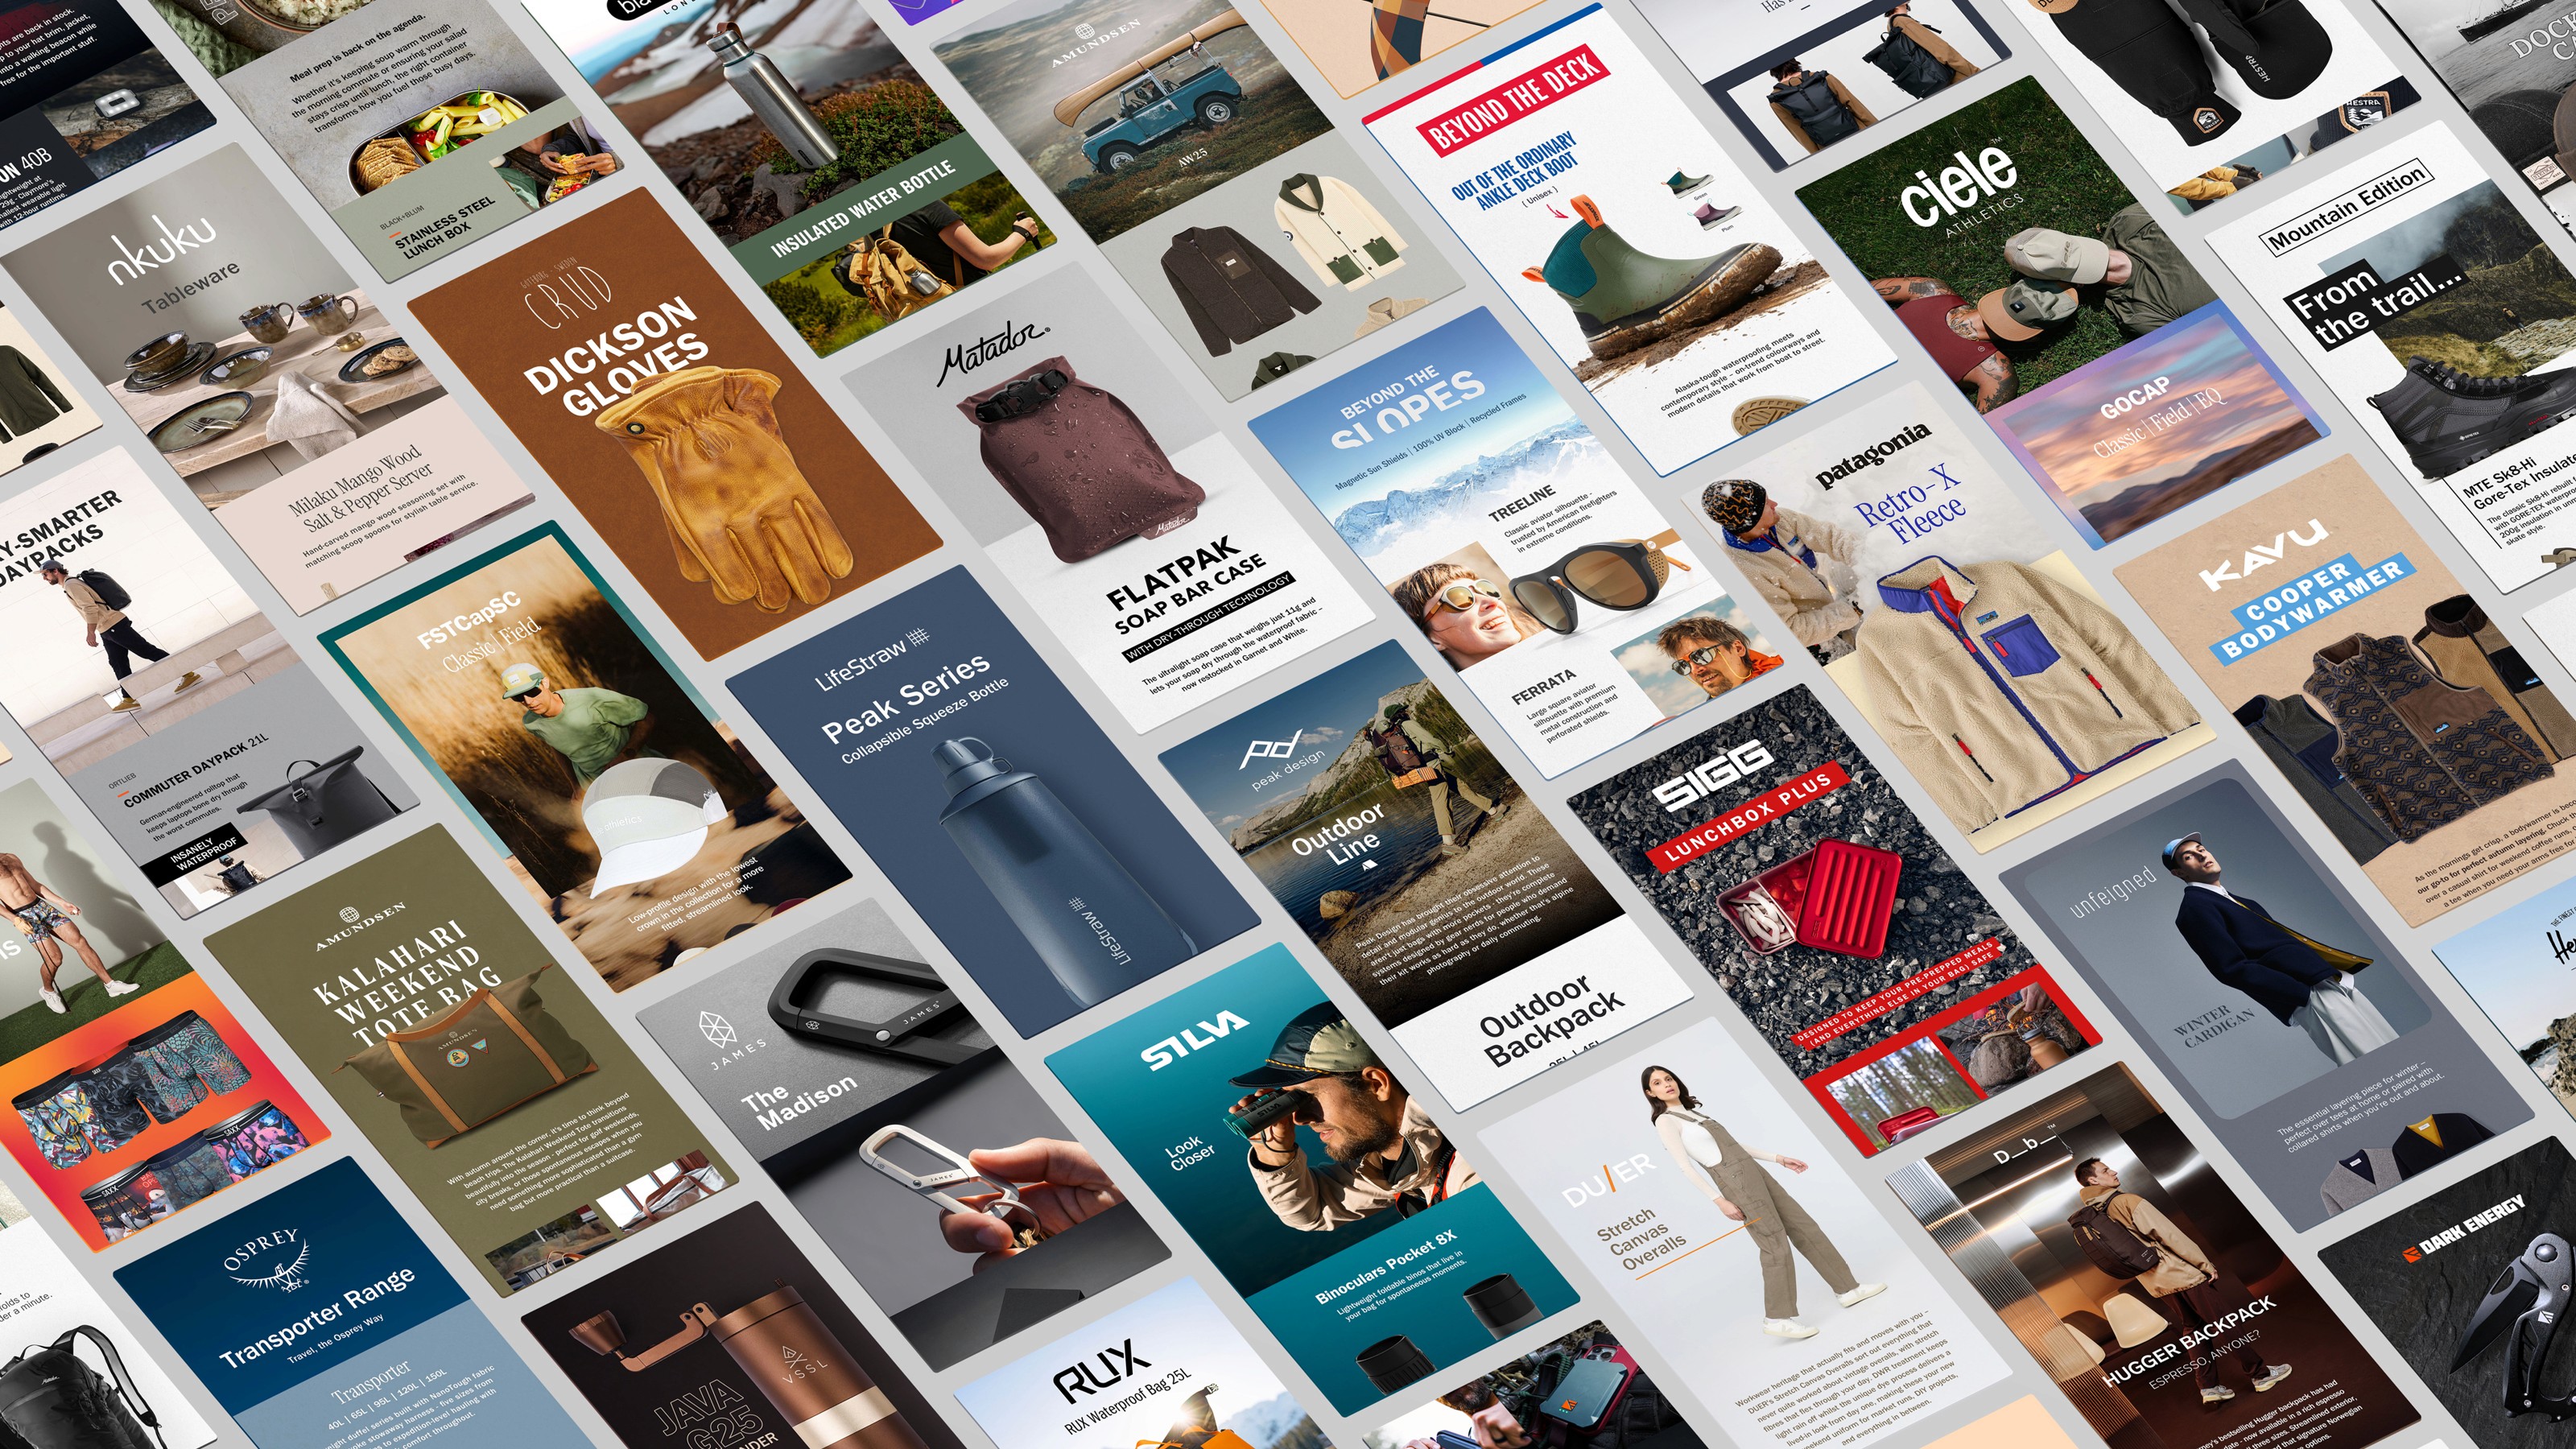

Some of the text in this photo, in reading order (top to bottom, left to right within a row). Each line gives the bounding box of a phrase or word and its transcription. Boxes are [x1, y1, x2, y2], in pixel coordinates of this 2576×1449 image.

[15, 36, 95, 79] for the important stuff.
[289, 68, 313, 83] Meal
[312, 59, 333, 73] prep
[341, 43, 365, 58] back
[365, 38, 377, 47] on
[376, 30, 392, 40] the
[392, 14, 426, 33] agenda.
[1052, 18, 1141, 68] AMUNDSEN
[1428, 52, 1601, 150] BEYOND THE DECK
[21, 147, 52, 170] 40B
[1179, 147, 1208, 167] AW25
[1451, 130, 1577, 201] OUT OF THE ORDINARY
[1476, 151, 1579, 211] ANKLE DECK BOOT
[770, 159, 956, 258] INSULATED WATER BOTTLE
[1526, 189, 1554, 204] Unisex
[1693, 192, 1708, 201] Green
[1901, 147, 2017, 228] ciele
[2268, 169, 2425, 251] Mountain Edition
[379, 204, 425, 230] BLACK+BLUM
[394, 196, 496, 250] STAINLESS STEEL
[402, 221, 472, 260] LUNCH BOX
[1721, 225, 1734, 233] Plum
[1946, 193, 2024, 238] ATHLETICS
[108, 214, 217, 286] nkuku
[141, 263, 240, 314] Tableware
[524, 266, 612, 329] CRUD
[2291, 271, 2378, 320] From
[2315, 272, 2462, 344] the trail...
[523, 295, 698, 396] DICKSON
[563, 332, 709, 416] GLOVES
[1340, 365, 1440, 420] BEYOND THE
[2100, 376, 2169, 419] GOCAP
[2093, 387, 2228, 458] Classic Field EQ
[287, 444, 423, 518] Milaku Mango Wood
[1335, 452, 1408, 491] Magnetic Sun Shields
[1814, 423, 1933, 491] patagonia
[1488, 484, 1556, 522] TREELINE
[1886, 499, 1967, 545] Fleece
[1105, 535, 1242, 612] FLATPAK
[1115, 553, 1267, 635] SOAP BAR CASE
[2246, 563, 2351, 621] COOPER
[416, 591, 521, 650] FSTCapSC
[1126, 574, 1290, 659] WITH DRY-THROUGH TECHNOLOGY
[2221, 561, 2405, 658] BODYWARMER
[442, 616, 542, 673] Classic Field
[815, 640, 906, 691] LifeStraw
[1181, 681, 1197, 692] now
[1197, 662, 1234, 684] restocked
[1241, 646, 1269, 662] Garnet
[1268, 638, 1283, 650] and
[1282, 628, 1308, 641] White.
[821, 656, 990, 745] Peak Series
[1511, 669, 1577, 706] FERRATA
[841, 679, 1009, 764] Collapsible Squeeze Bottle
[108, 772, 137, 790] ORTLIEB
[123, 733, 269, 808] COMMUTER DAYPACK 21L
[1252, 750, 1326, 792] peak design
[1651, 739, 1775, 813] SIGG
[1291, 803, 1385, 856] Outdoor
[1664, 774, 1831, 862] LUNCHBOX PLUS
[170, 837, 213, 864] INSANELY
[176, 836, 237, 871] WATERPROOF
[1326, 834, 1381, 866] Line
[2070, 865, 2157, 919] unfeigned
[316, 902, 406, 952] AMUNDSEN
[1081, 911, 1132, 965] LifeStraw
[312, 919, 467, 1005] KALAHARI
[334, 946, 479, 1025] WEEKEND
[352, 966, 502, 1047] TOTE BAG
[1797, 942, 1993, 1042] DESIGNED TO KEEP YOUR PRE-PREPPED MEALS
[1141, 1009, 1250, 1071] SILVA
[2174, 1005, 2231, 1036] WINTER
[2185, 1008, 2256, 1048] CARDIGAN
[711, 1038, 766, 1071] JAMES
[741, 1086, 789, 1113] The
[756, 1077, 858, 1131] Madison
[224, 1121, 241, 1137] SAXX
[1165, 1136, 1203, 1158] Look
[1170, 1145, 1216, 1171] Closer
[224, 1228, 298, 1271] OSPREY
[1597, 1209, 1656, 1242] Stretch
[1610, 1224, 1669, 1256] Canvas
[2418, 1194, 2526, 1255] DARK ENERGY
[1315, 1228, 1458, 1305] Binoculars Pocket 8X
[1622, 1236, 1686, 1270] Overalls
[218, 1269, 415, 1368] Transporter Range
[287, 1314, 384, 1364] Travel, the Osprey Way
[2101, 1294, 2277, 1388] HUGGER BACKPACK
[1053, 1338, 1152, 1405] RUX
[2149, 1329, 2260, 1390] ESPRESSO, ANYONE?
[1063, 1368, 1192, 1435] RUX Waterproof Bag 25L
